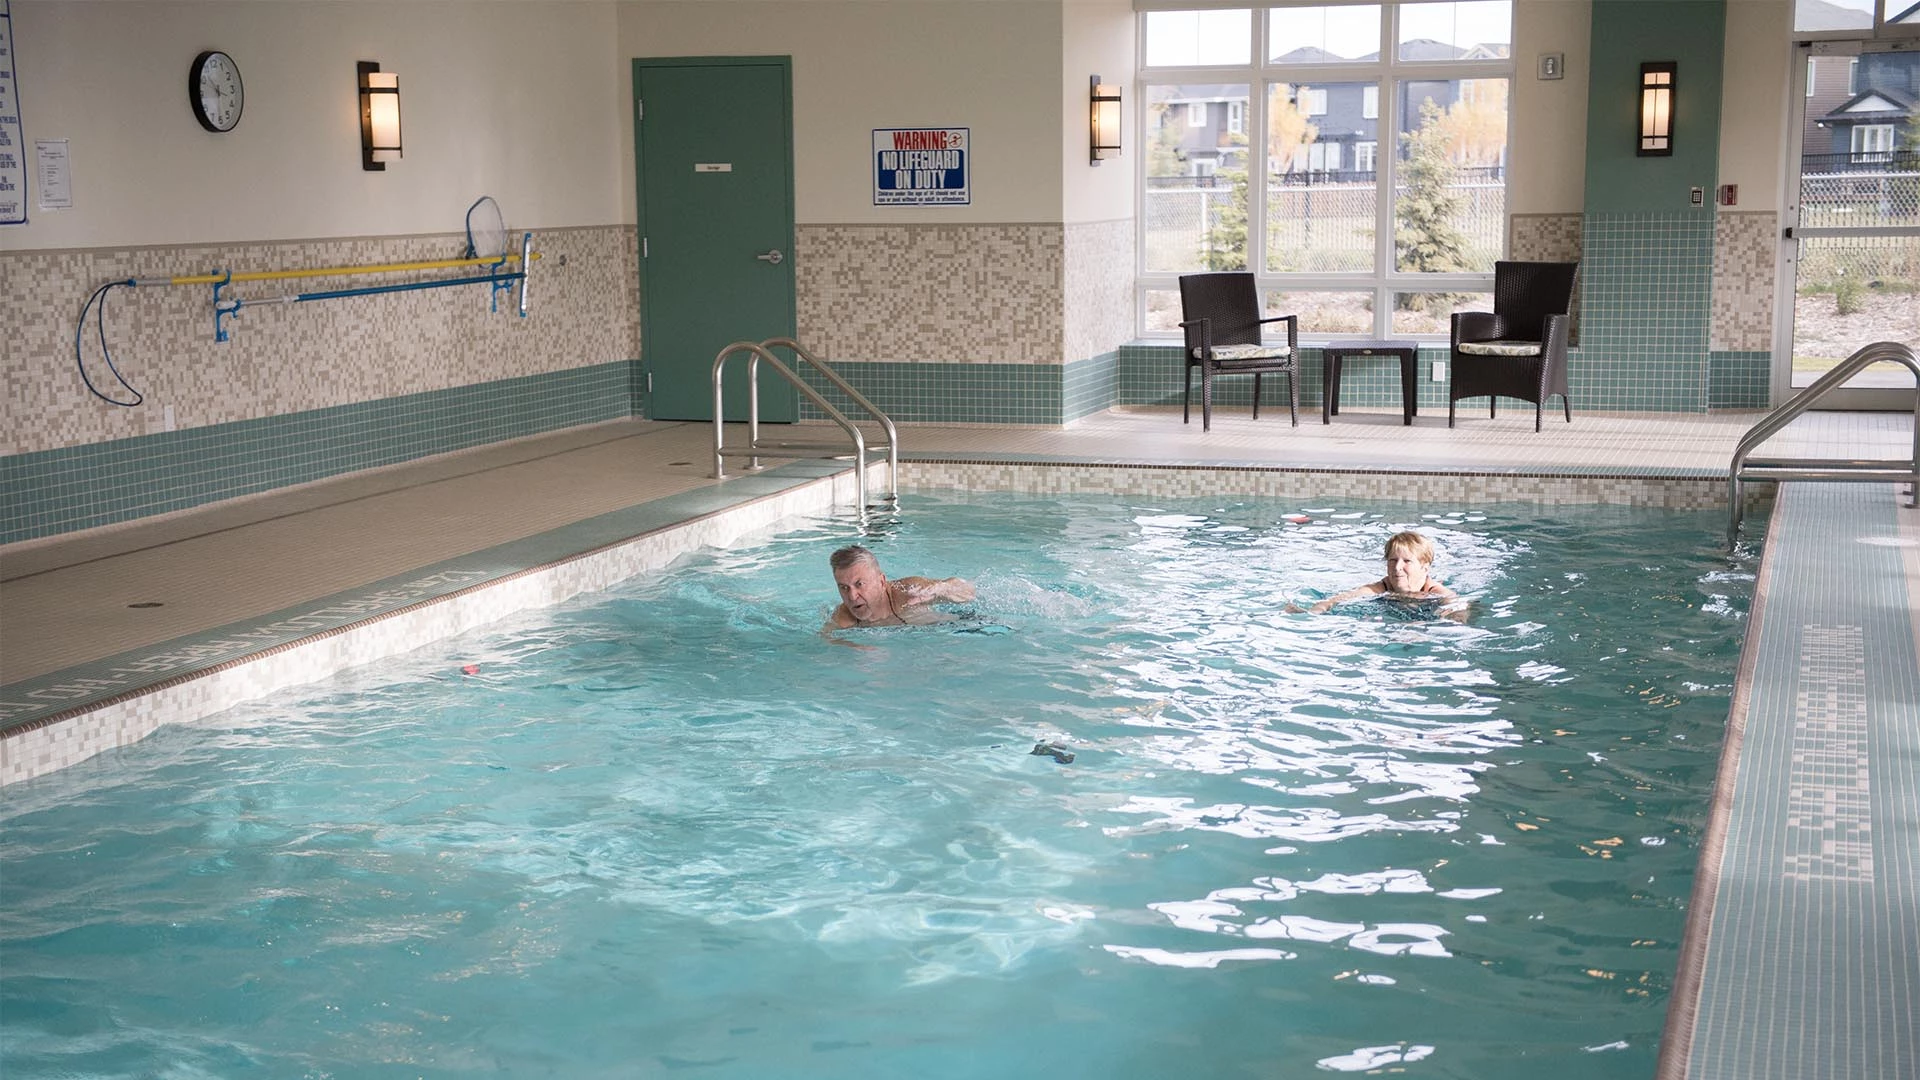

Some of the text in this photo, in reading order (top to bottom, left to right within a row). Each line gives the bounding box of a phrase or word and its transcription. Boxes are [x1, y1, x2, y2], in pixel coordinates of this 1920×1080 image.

[893, 131, 947, 150] WARNING
[882, 150, 960, 170] NO LIFEGUARD
[895, 170, 946, 189] ON DUTY
